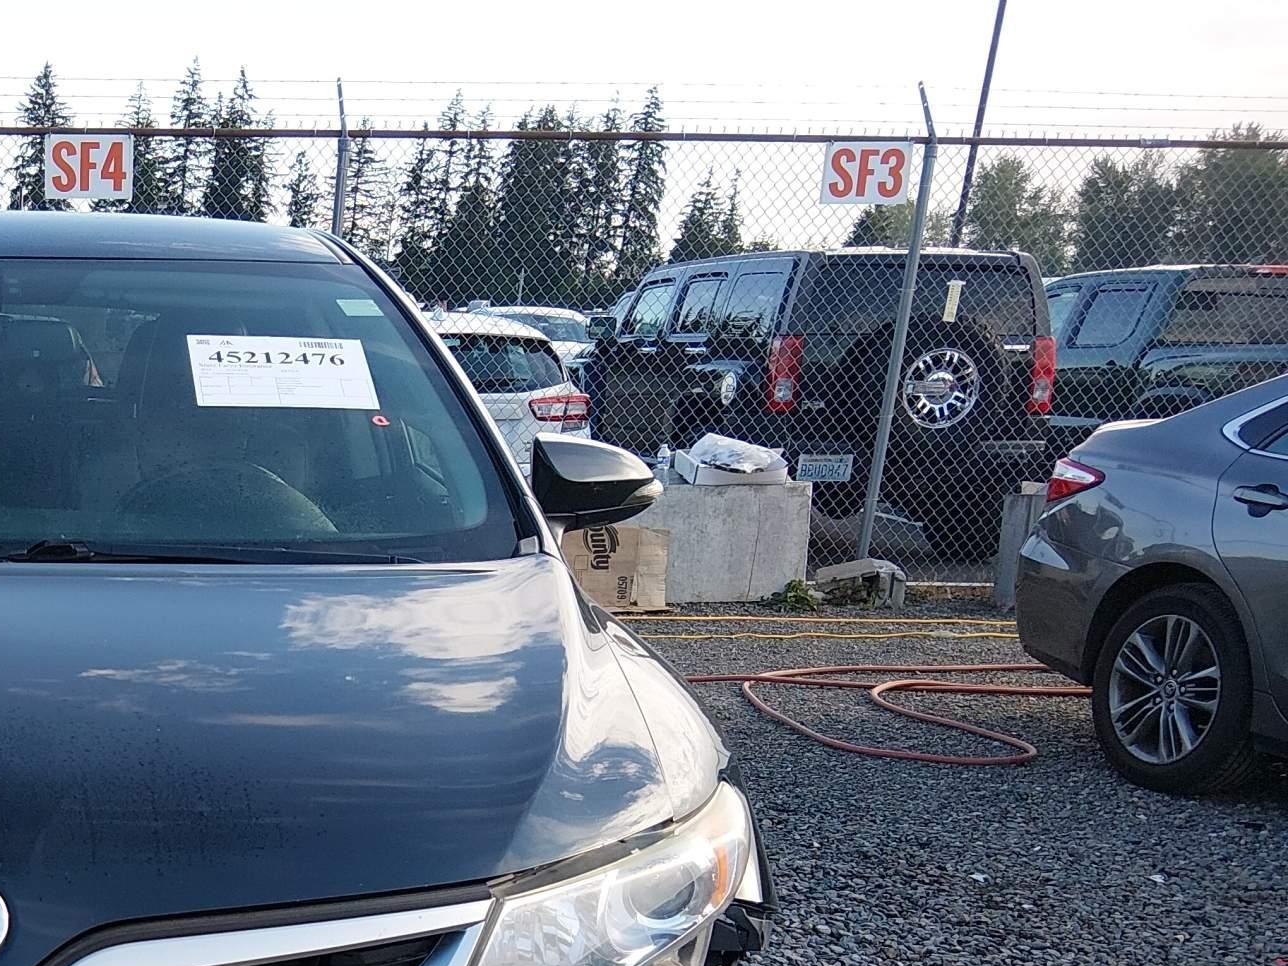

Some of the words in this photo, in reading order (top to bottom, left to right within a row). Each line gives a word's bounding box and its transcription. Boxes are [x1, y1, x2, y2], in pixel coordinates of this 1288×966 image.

[51, 141, 127, 193] SF4
[828, 148, 906, 198] SF3
[207, 349, 345, 366] 45212476
